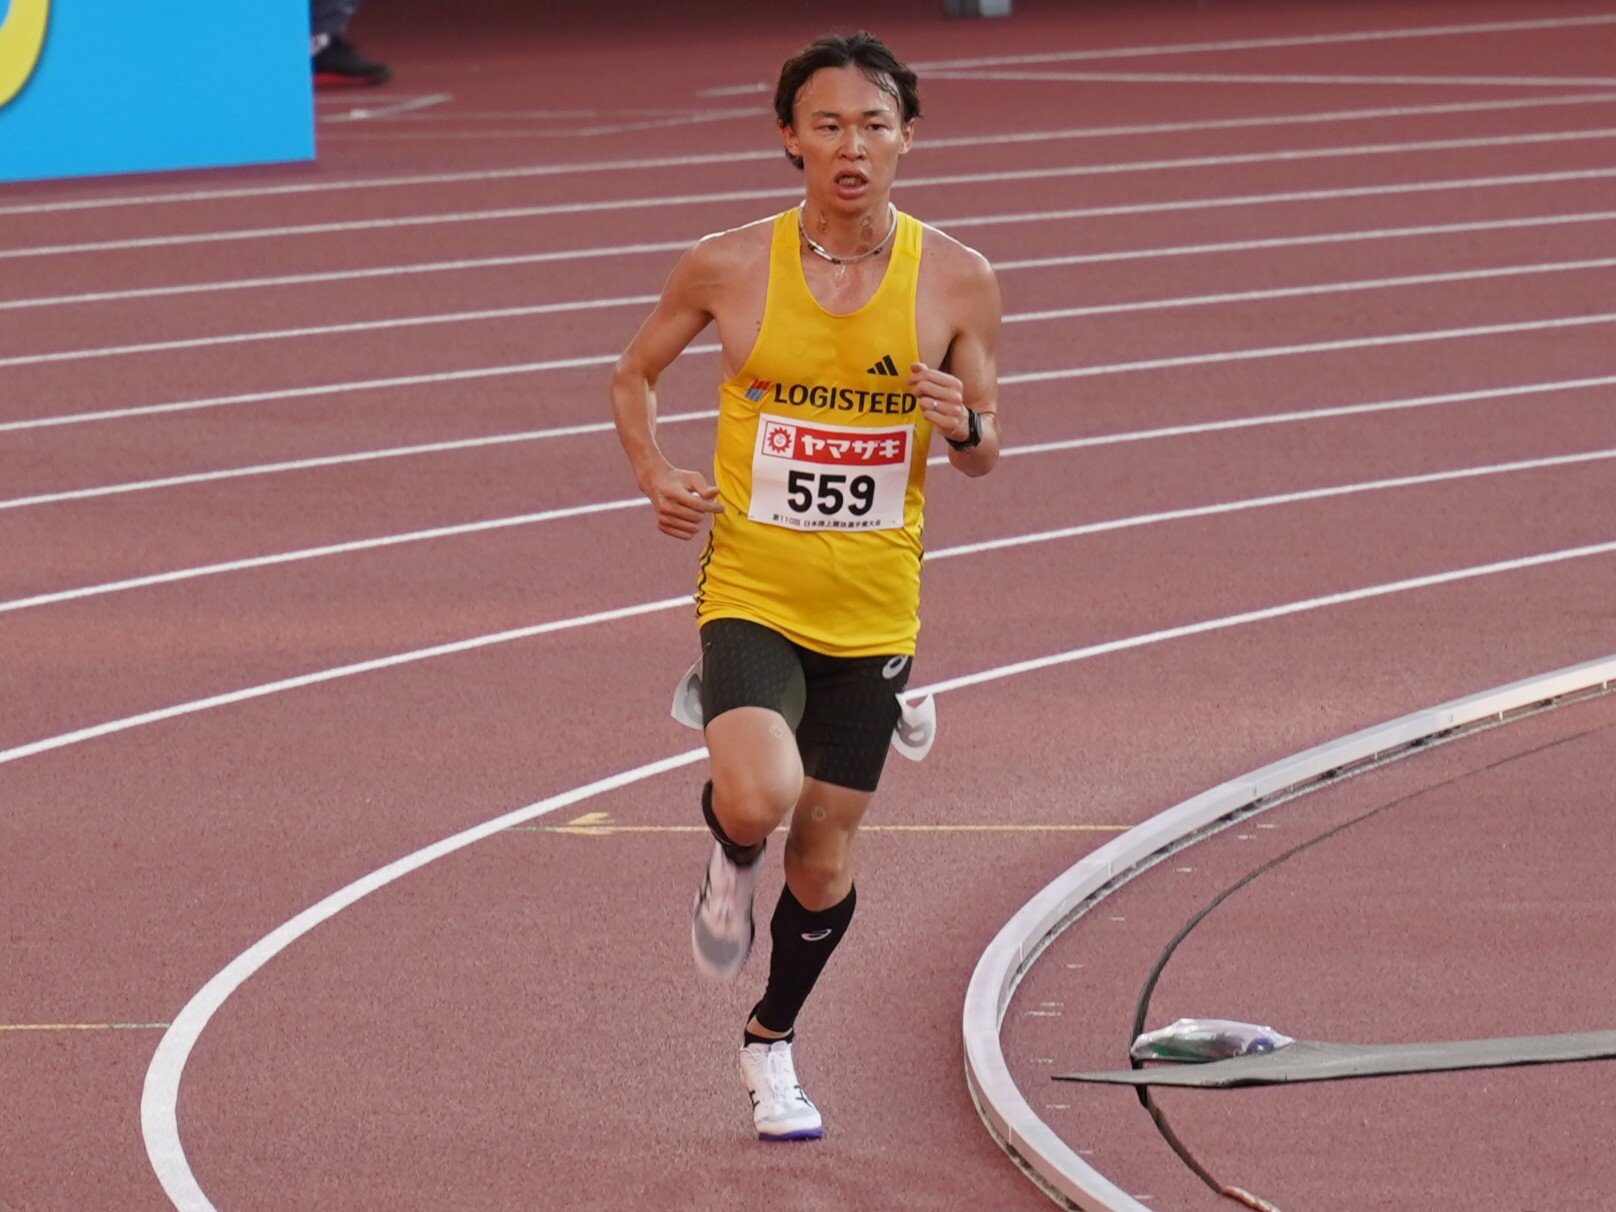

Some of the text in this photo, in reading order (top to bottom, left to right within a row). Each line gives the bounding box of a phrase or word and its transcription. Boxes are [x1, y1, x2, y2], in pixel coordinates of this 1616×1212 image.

[774, 384, 917, 414] LOGISTEED
[801, 435, 901, 460] ヤマザキ
[787, 470, 876, 516] 559
